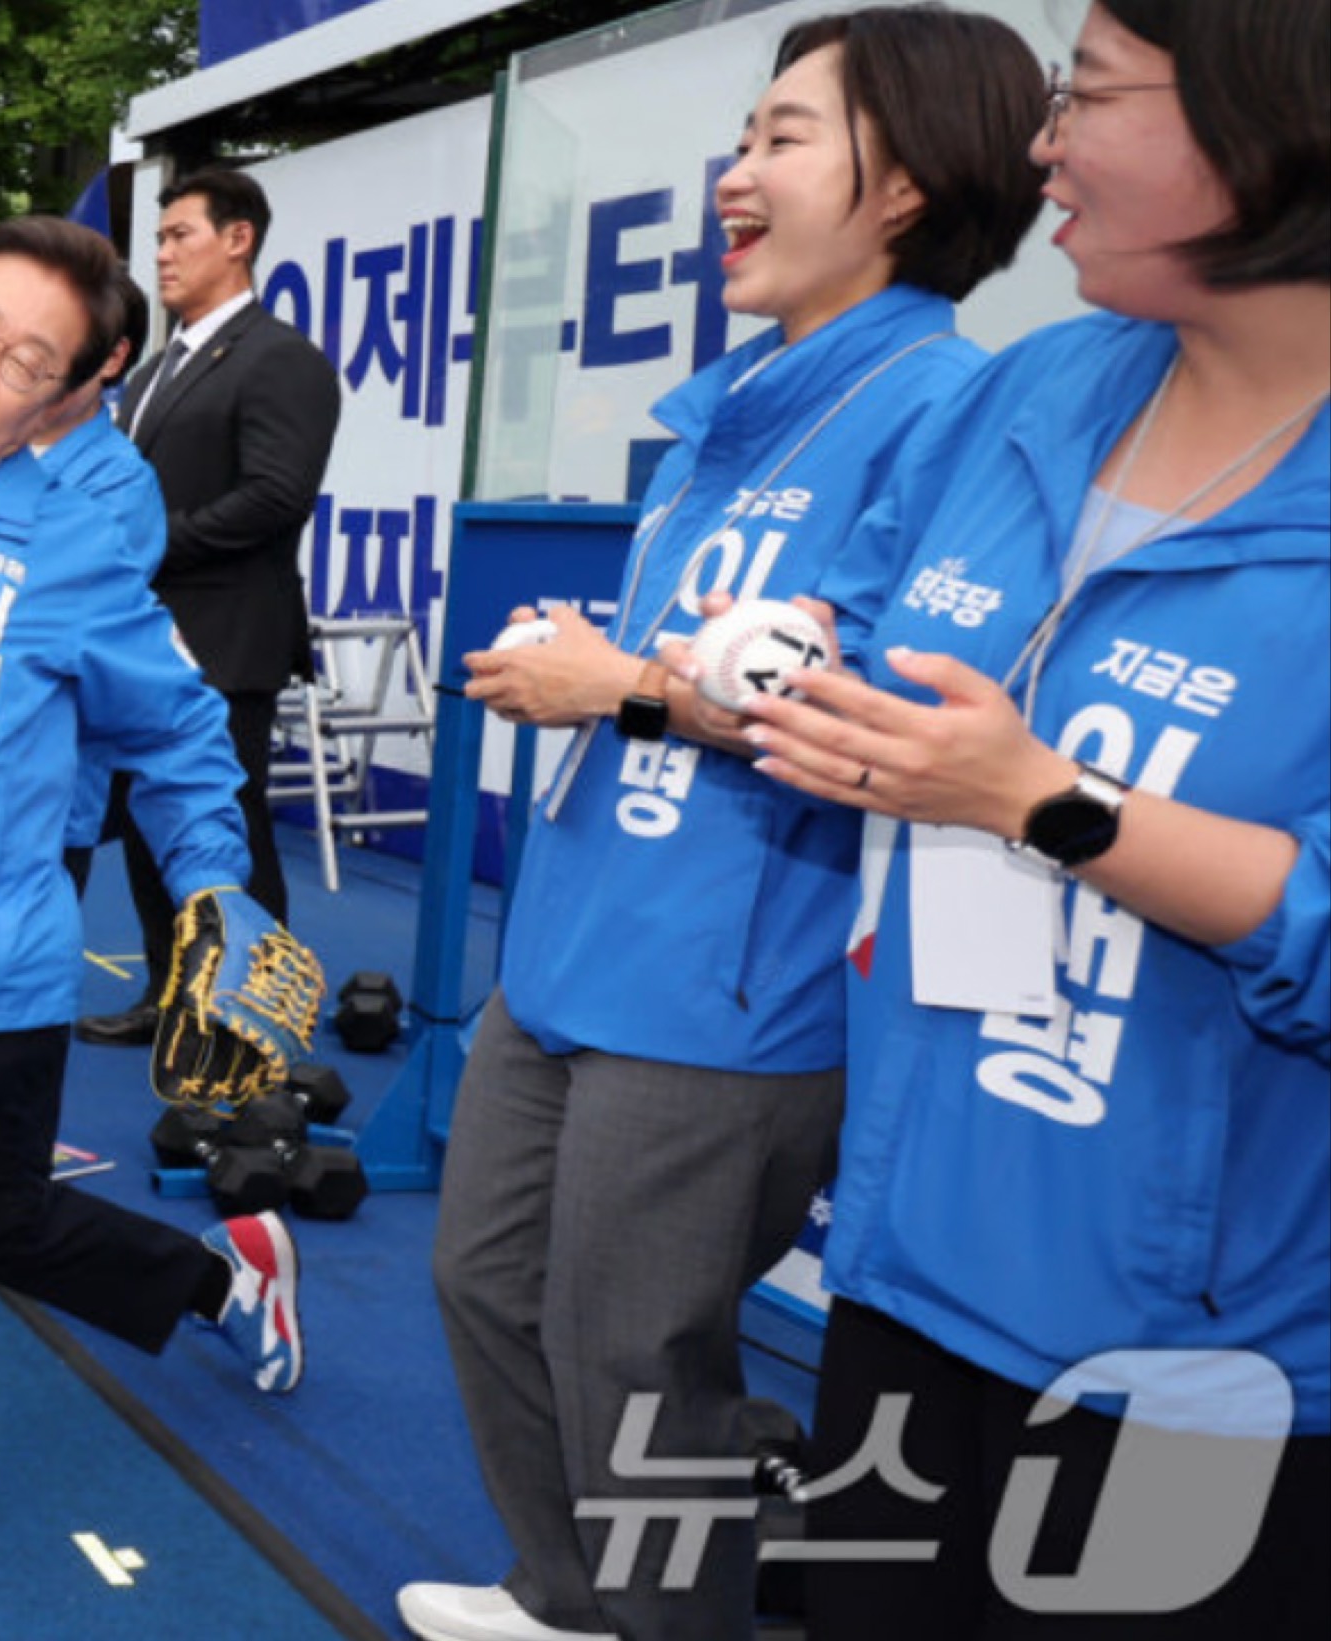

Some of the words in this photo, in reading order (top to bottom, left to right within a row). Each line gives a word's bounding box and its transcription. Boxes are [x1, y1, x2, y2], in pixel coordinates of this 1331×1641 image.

[903, 558, 1003, 628] 민주당
[616, 527, 788, 838] 이명
[1092, 639, 1238, 717] 지금은
